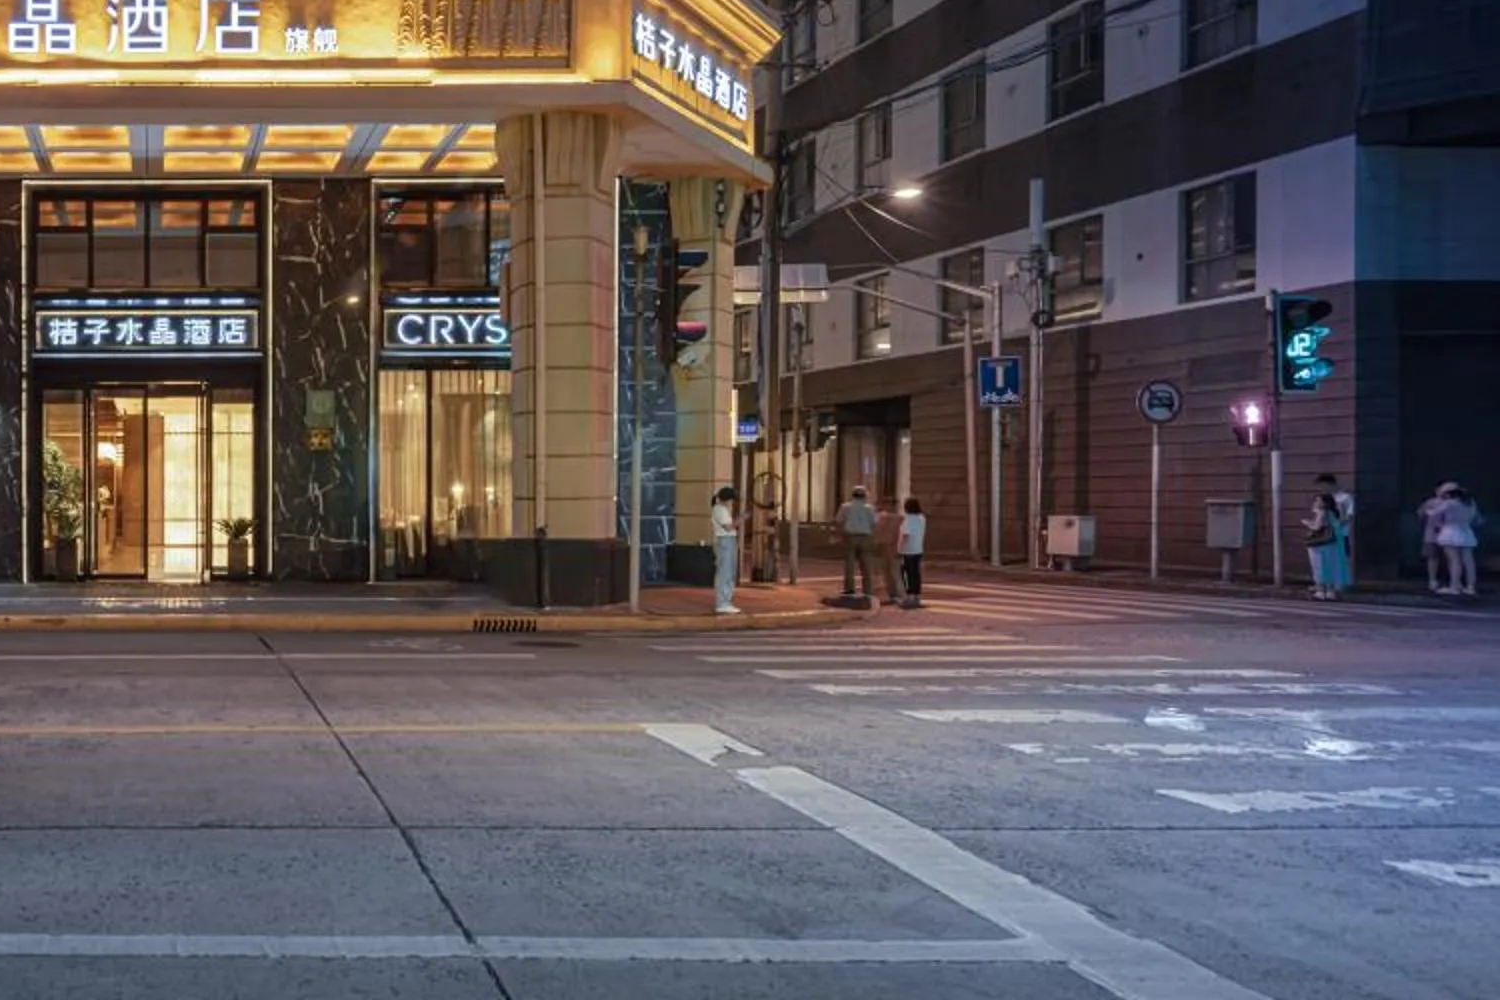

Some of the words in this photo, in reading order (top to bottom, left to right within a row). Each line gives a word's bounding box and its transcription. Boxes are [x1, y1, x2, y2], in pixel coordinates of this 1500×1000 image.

[634, 12, 749, 121] 桔子水晶酒店
[48, 317, 248, 346] 桔子水晶酒店
